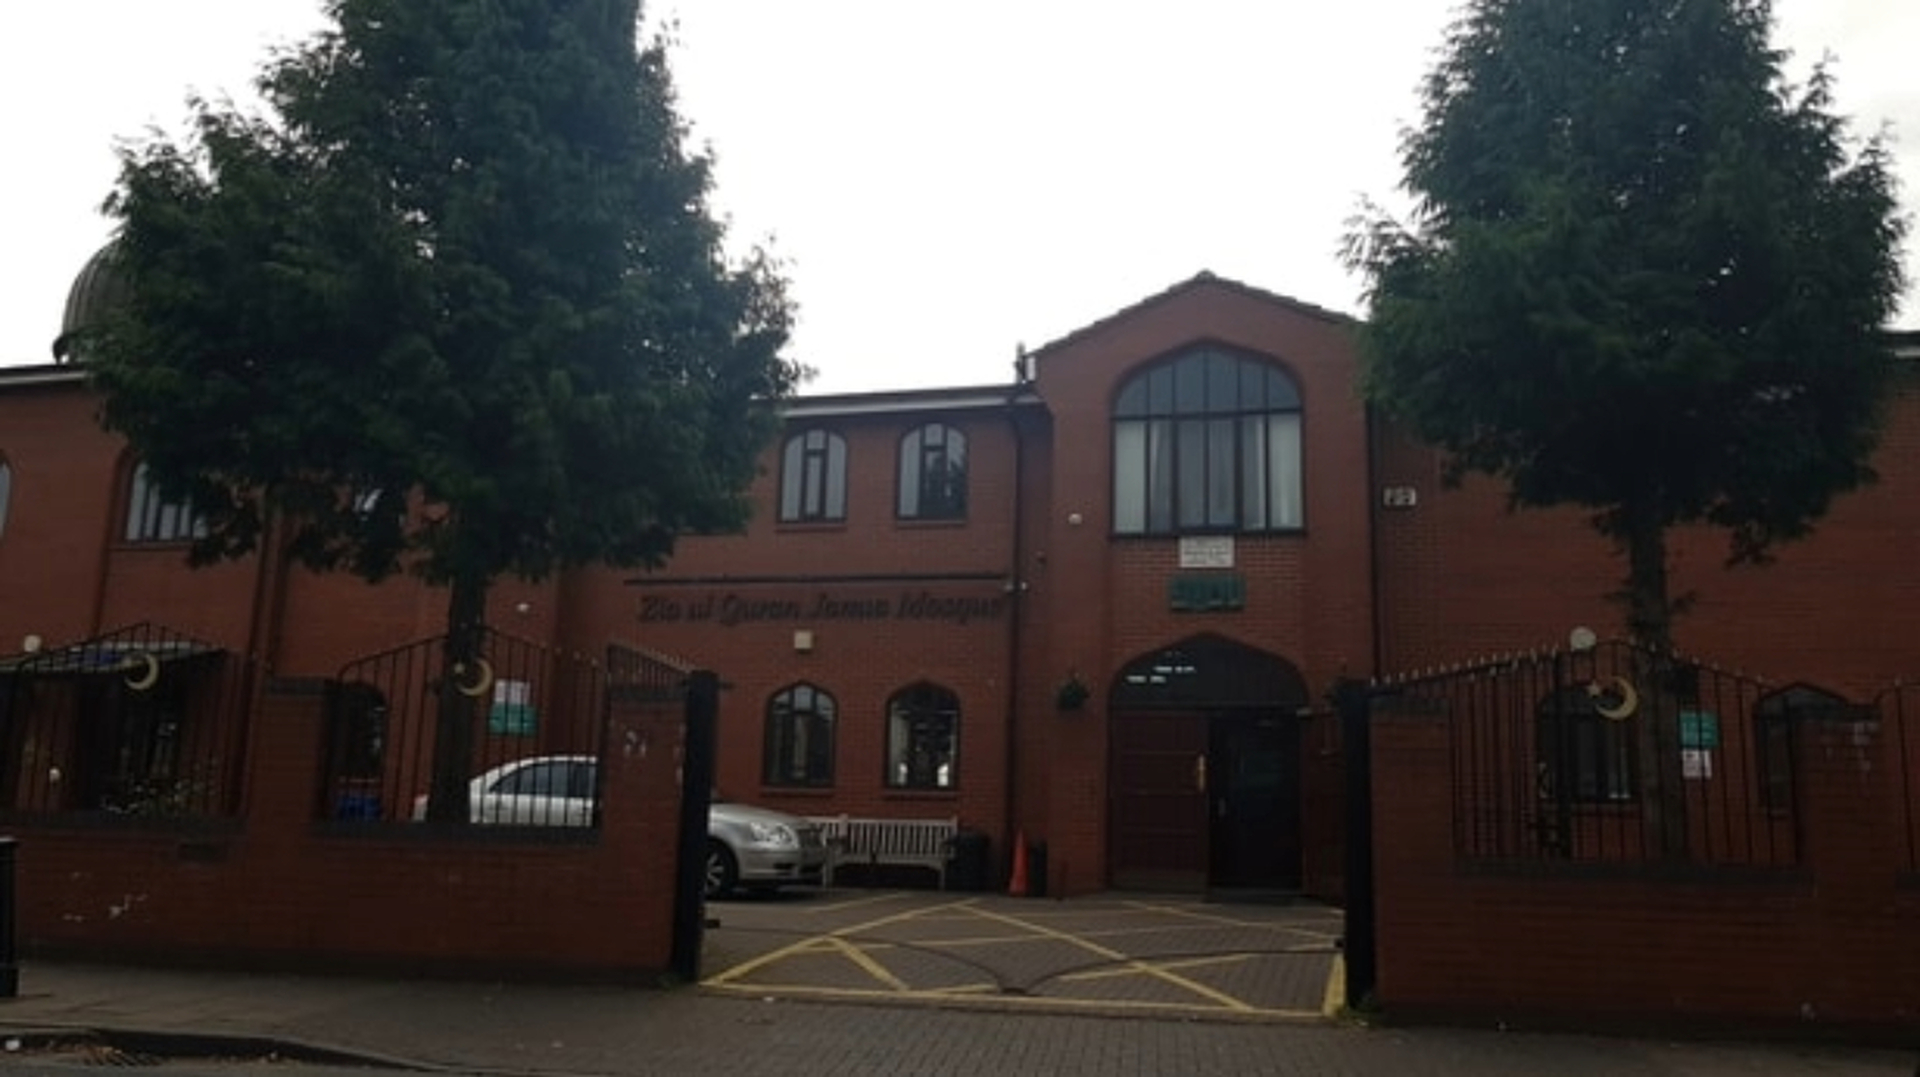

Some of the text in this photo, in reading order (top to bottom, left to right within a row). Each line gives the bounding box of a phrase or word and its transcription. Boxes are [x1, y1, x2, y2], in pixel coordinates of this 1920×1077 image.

[639, 595, 682, 622] Zia
[687, 594, 714, 621] ul
[719, 593, 800, 627] Quran
[896, 591, 1004, 626] Mosque
